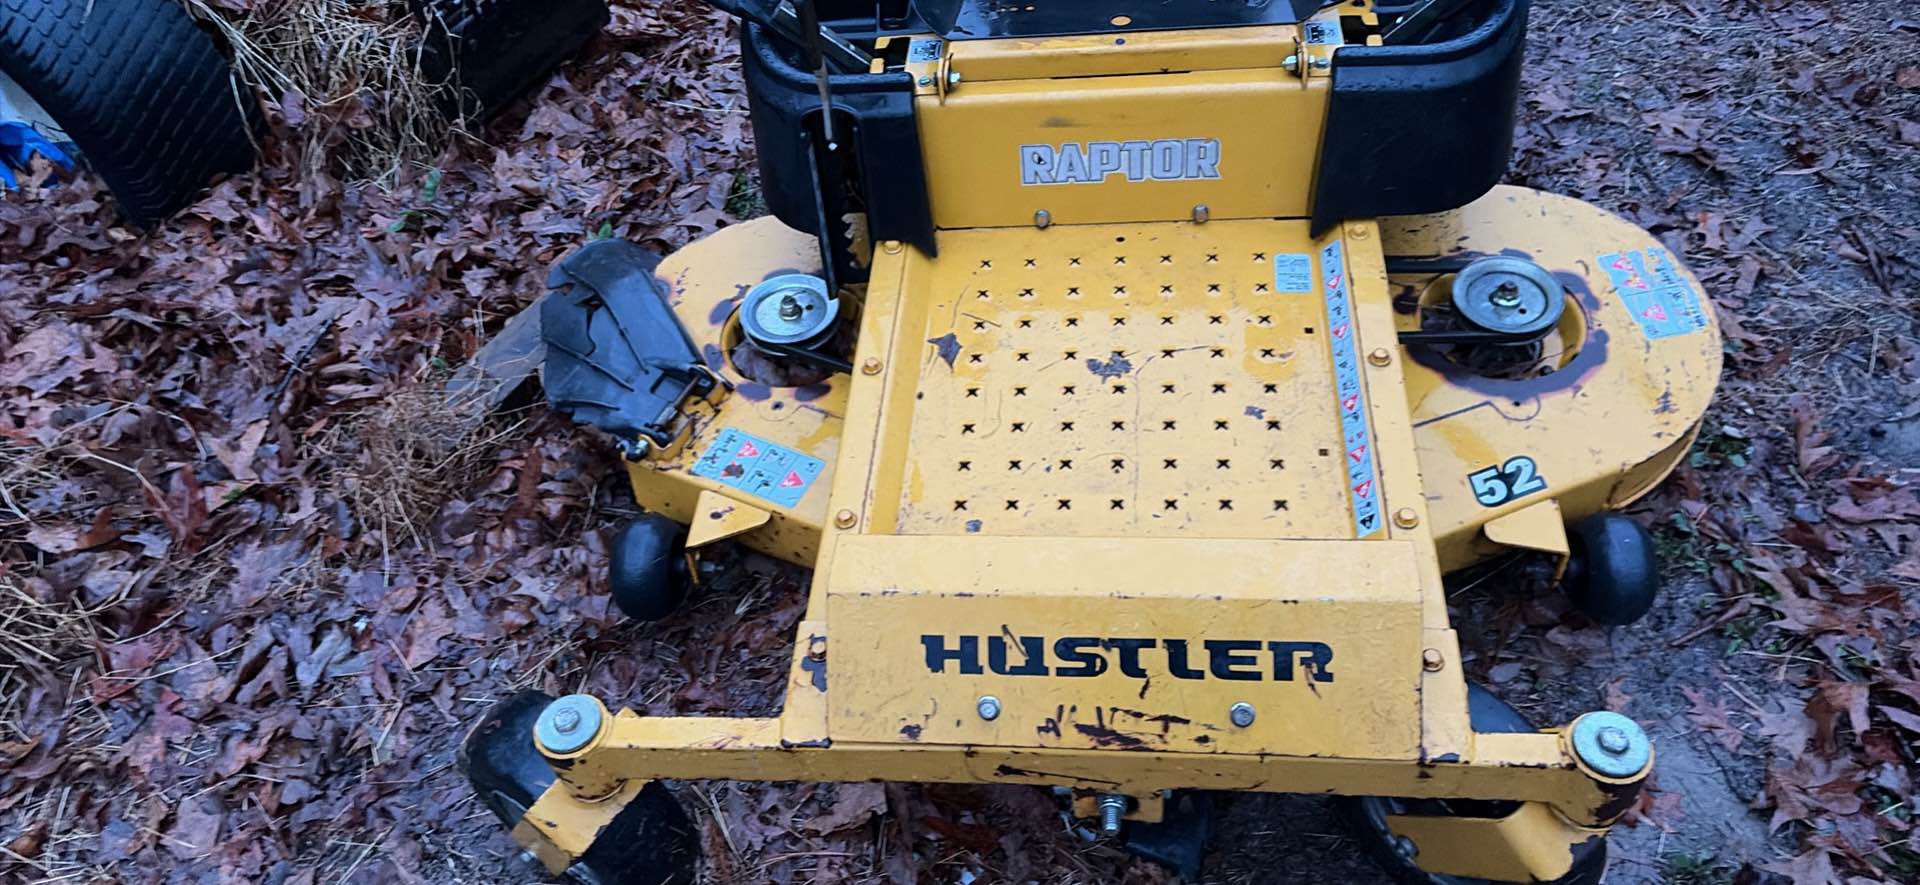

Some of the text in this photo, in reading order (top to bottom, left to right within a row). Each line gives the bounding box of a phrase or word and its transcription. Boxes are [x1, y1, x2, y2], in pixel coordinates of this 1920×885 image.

[1020, 138, 1221, 185] RAPTOR
[1467, 456, 1548, 507] 52
[921, 634, 1334, 682] HUSTLER
